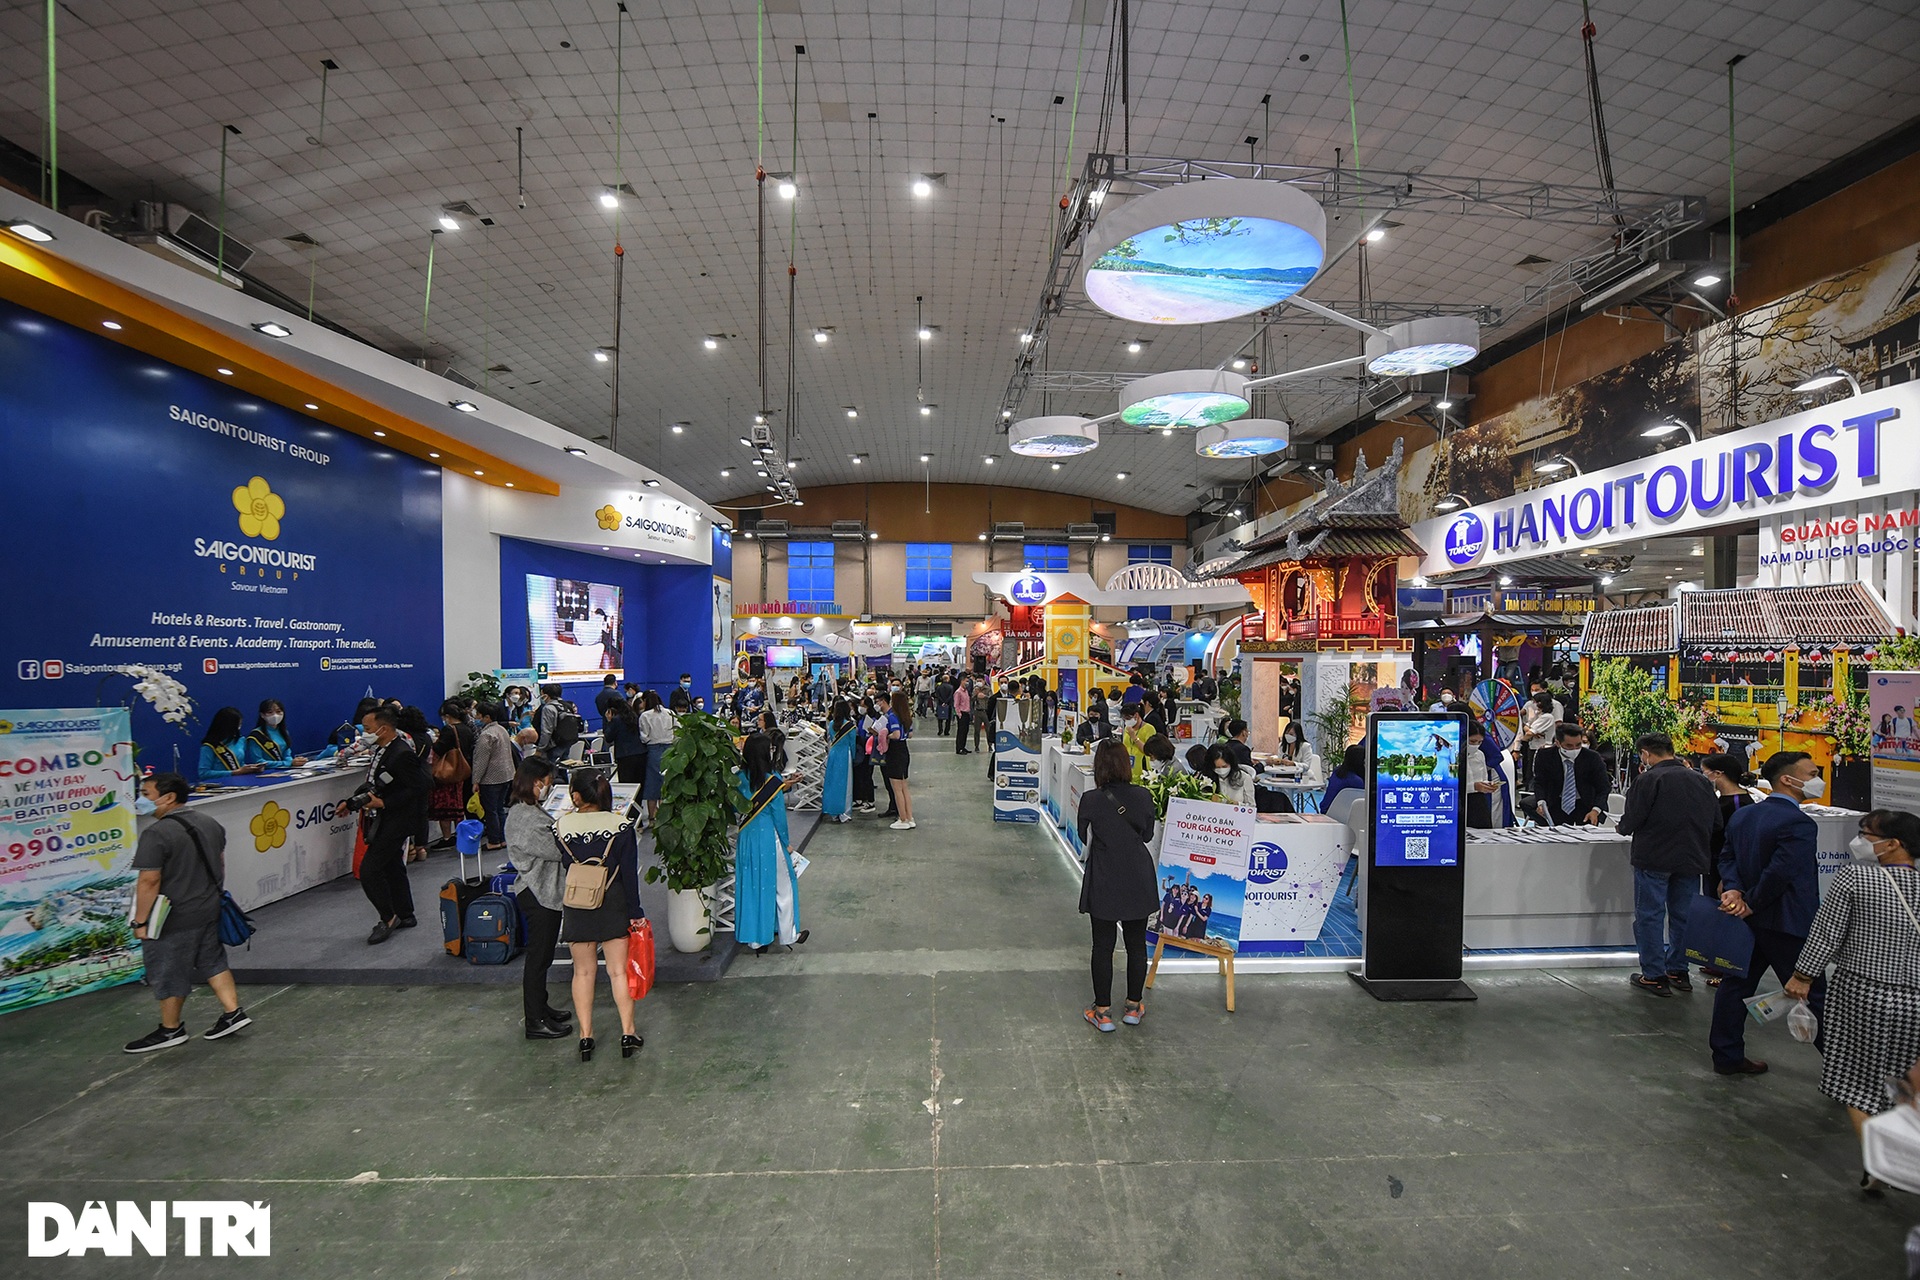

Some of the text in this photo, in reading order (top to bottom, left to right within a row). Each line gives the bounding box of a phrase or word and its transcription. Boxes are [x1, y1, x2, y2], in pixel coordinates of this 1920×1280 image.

[169, 404, 330, 466] SAIGONTOURIST GROUP
[1493, 407, 1897, 550] HANOITOURIST
[625, 515, 688, 539] SAIGONTOURIST
[1781, 509, 1919, 542] QUẢNG NAM
[194, 538, 316, 571] SAIGONTOURIST
[1760, 551, 1791, 565] NĂM
[1795, 550, 1813, 561] DU
[1818, 545, 1853, 561] LỊCH
[1857, 535, 1909, 555] QUỐC
[220, 563, 299, 581] GROUP
[231, 581, 288, 595] Savour Vietnam
[736, 602, 759, 614] THÀNH
[820, 604, 842, 615] MINH
[1505, 599, 1519, 611] TAM
[151, 611, 192, 626] Hotels
[194, 614, 204, 626] &
[206, 614, 247, 628] Resorts
[253, 616, 283, 629] Travel
[90, 633, 175, 648] Amusement
[177, 635, 188, 648] &
[189, 635, 228, 648] Events
[235, 636, 283, 651] Academy
[288, 638, 330, 651] Transport
[336, 638, 350, 649] The
[1005, 630, 1016, 638] HÀ
[1018, 630, 1030, 639] NỘI
[218, 661, 299, 671] www.saigontourist.com.vn
[16, 719, 101, 730] SAIGONTOURIST
[0, 750, 103, 777] COMBO
[34, 776, 61, 789] MÁY
[63, 775, 87, 786] BAY
[68, 784, 107, 799] PHÒNG
[15, 800, 93, 820] BAMBOO
[1185, 812, 1234, 826] Ở ĐÂY CÓ BÁN
[33, 825, 53, 836] GIÁ
[1176, 821, 1242, 837] TOUR GIÁ SHOCK
[1181, 832, 1234, 847] TẠI HỘI CHỢ
[1817, 851, 1850, 860] Lữ hành
